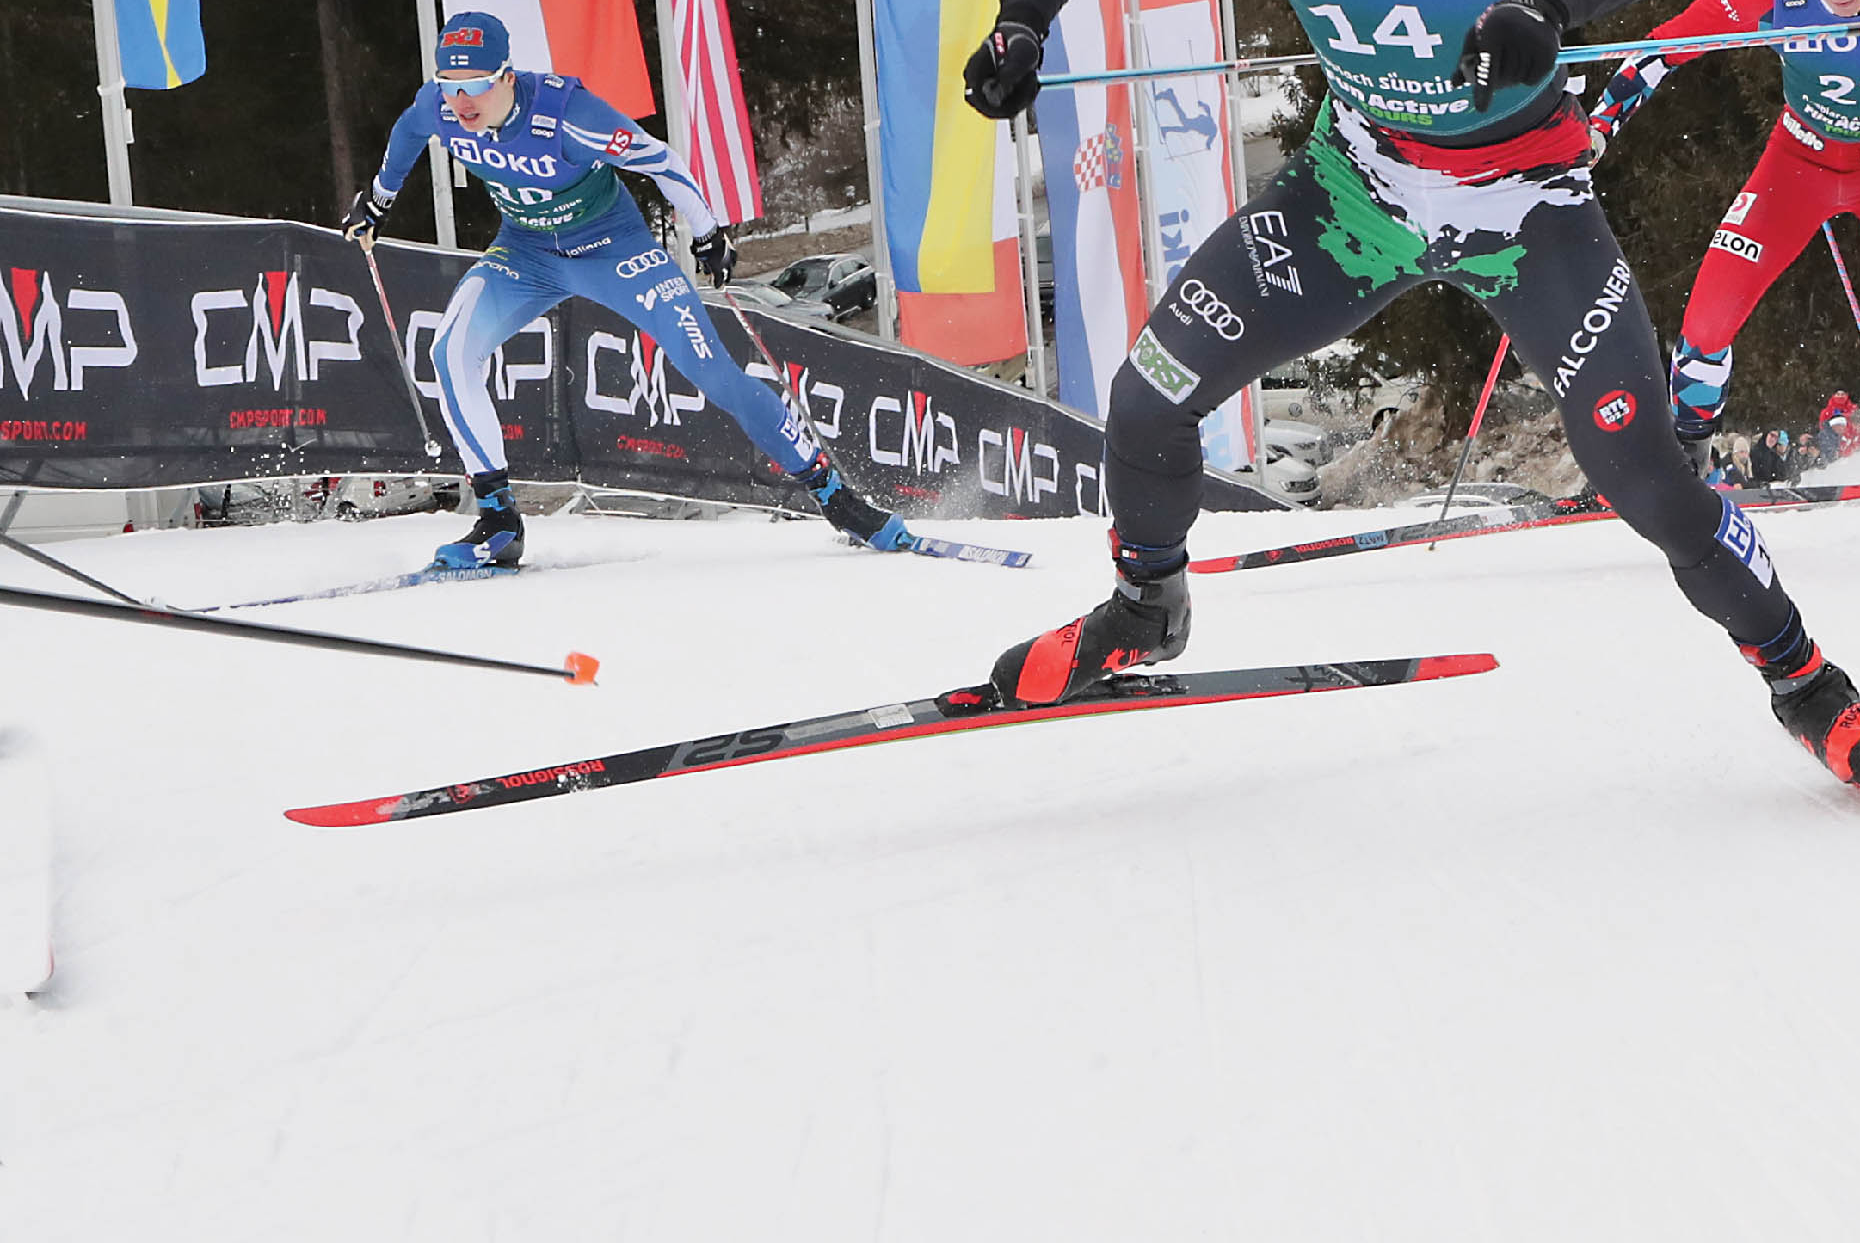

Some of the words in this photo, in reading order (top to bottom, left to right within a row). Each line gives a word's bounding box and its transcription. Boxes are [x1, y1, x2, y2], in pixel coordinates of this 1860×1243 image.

[1308, 3, 1444, 59] 14
[1365, 93, 1470, 115] Active
[450, 136, 558, 177] HOKU
[1250, 211, 1303, 296] EA7
[655, 276, 685, 294] INTER
[660, 286, 690, 303] SPORT
[0, 270, 138, 401] MP
[191, 271, 364, 391] CMP
[674, 305, 713, 359] swix
[1168, 302, 1193, 326] Audi
[405, 309, 552, 401] CP
[869, 390, 960, 476] CMP
[1598, 396, 1629, 420] RTL
[978, 428, 1059, 504] CMP
[496, 759, 606, 790] ROSSIGNOL
